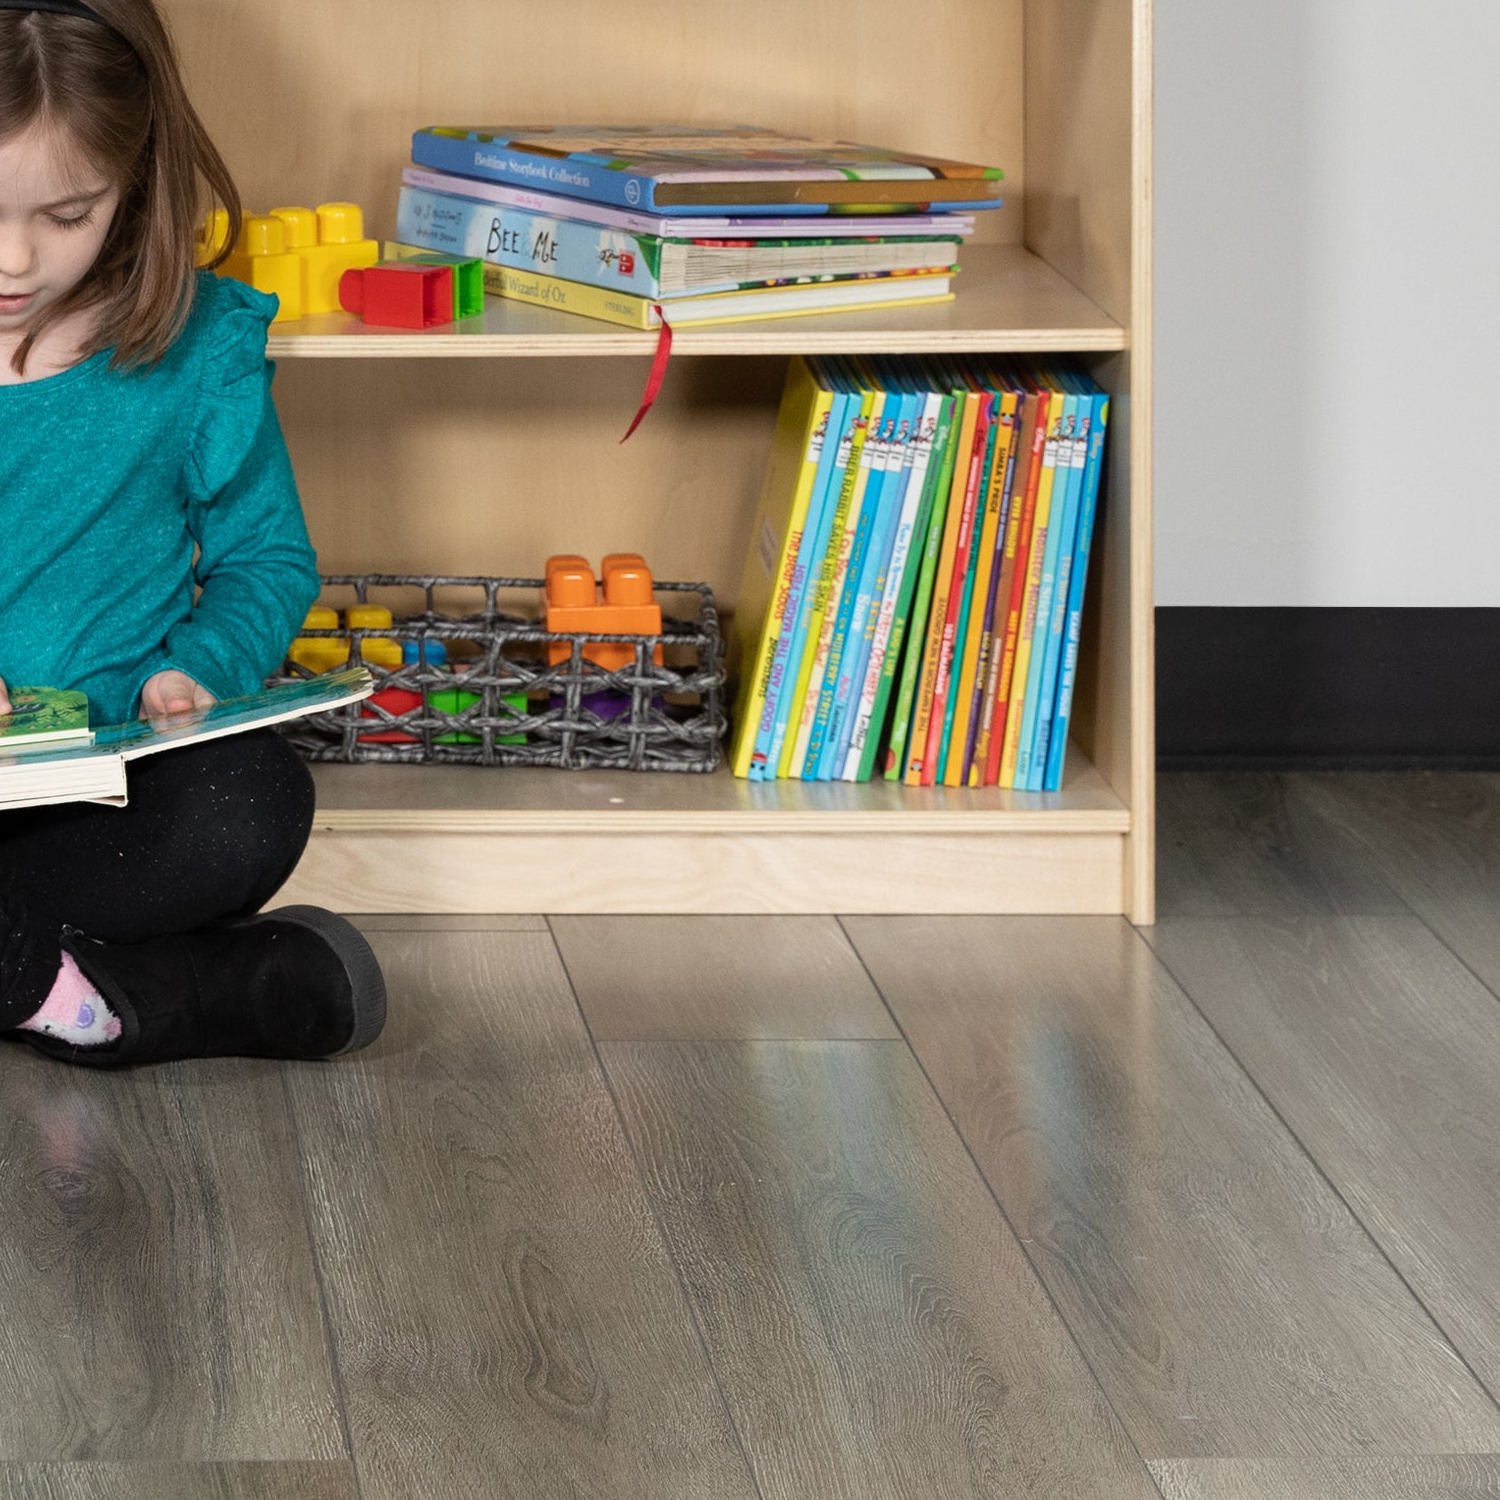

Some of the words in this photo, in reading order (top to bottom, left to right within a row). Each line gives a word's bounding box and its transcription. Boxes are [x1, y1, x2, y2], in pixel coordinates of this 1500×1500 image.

[550, 167, 590, 187] Collection
[509, 276, 539, 297] Wizard
[541, 284, 550, 301] of
[552, 287, 565, 304] Oz
[1031, 427, 1044, 453] Disney
[845, 446, 861, 475] BRER
[992, 446, 1007, 484] SIMBA'S
[835, 478, 853, 520] RABBIT
[988, 487, 1000, 513] PRIDE
[788, 530, 803, 551] The
[825, 523, 843, 559] SAVES
[1030, 526, 1047, 578] Monster
[781, 553, 798, 580] Bear
[790, 564, 806, 590] FISH
[819, 562, 834, 582] HIS
[812, 585, 828, 612] SKIN
[849, 593, 871, 632] Snow
[1036, 587, 1052, 627] Sticks
[780, 595, 799, 631] MAGIC
[895, 617, 905, 625] A
[932, 596, 947, 635] GROOVE
[775, 638, 789, 657] THE
[888, 627, 903, 656] BUG'S
[928, 637, 940, 659] NEW
[824, 632, 845, 685] MULBERRY
[883, 659, 896, 676] LIFE
[768, 663, 784, 687] AND
[919, 661, 936, 712] EMPEROR'S
[758, 692, 778, 732] GOOFY
[815, 689, 833, 726] STREET
[916, 715, 928, 731] THE
